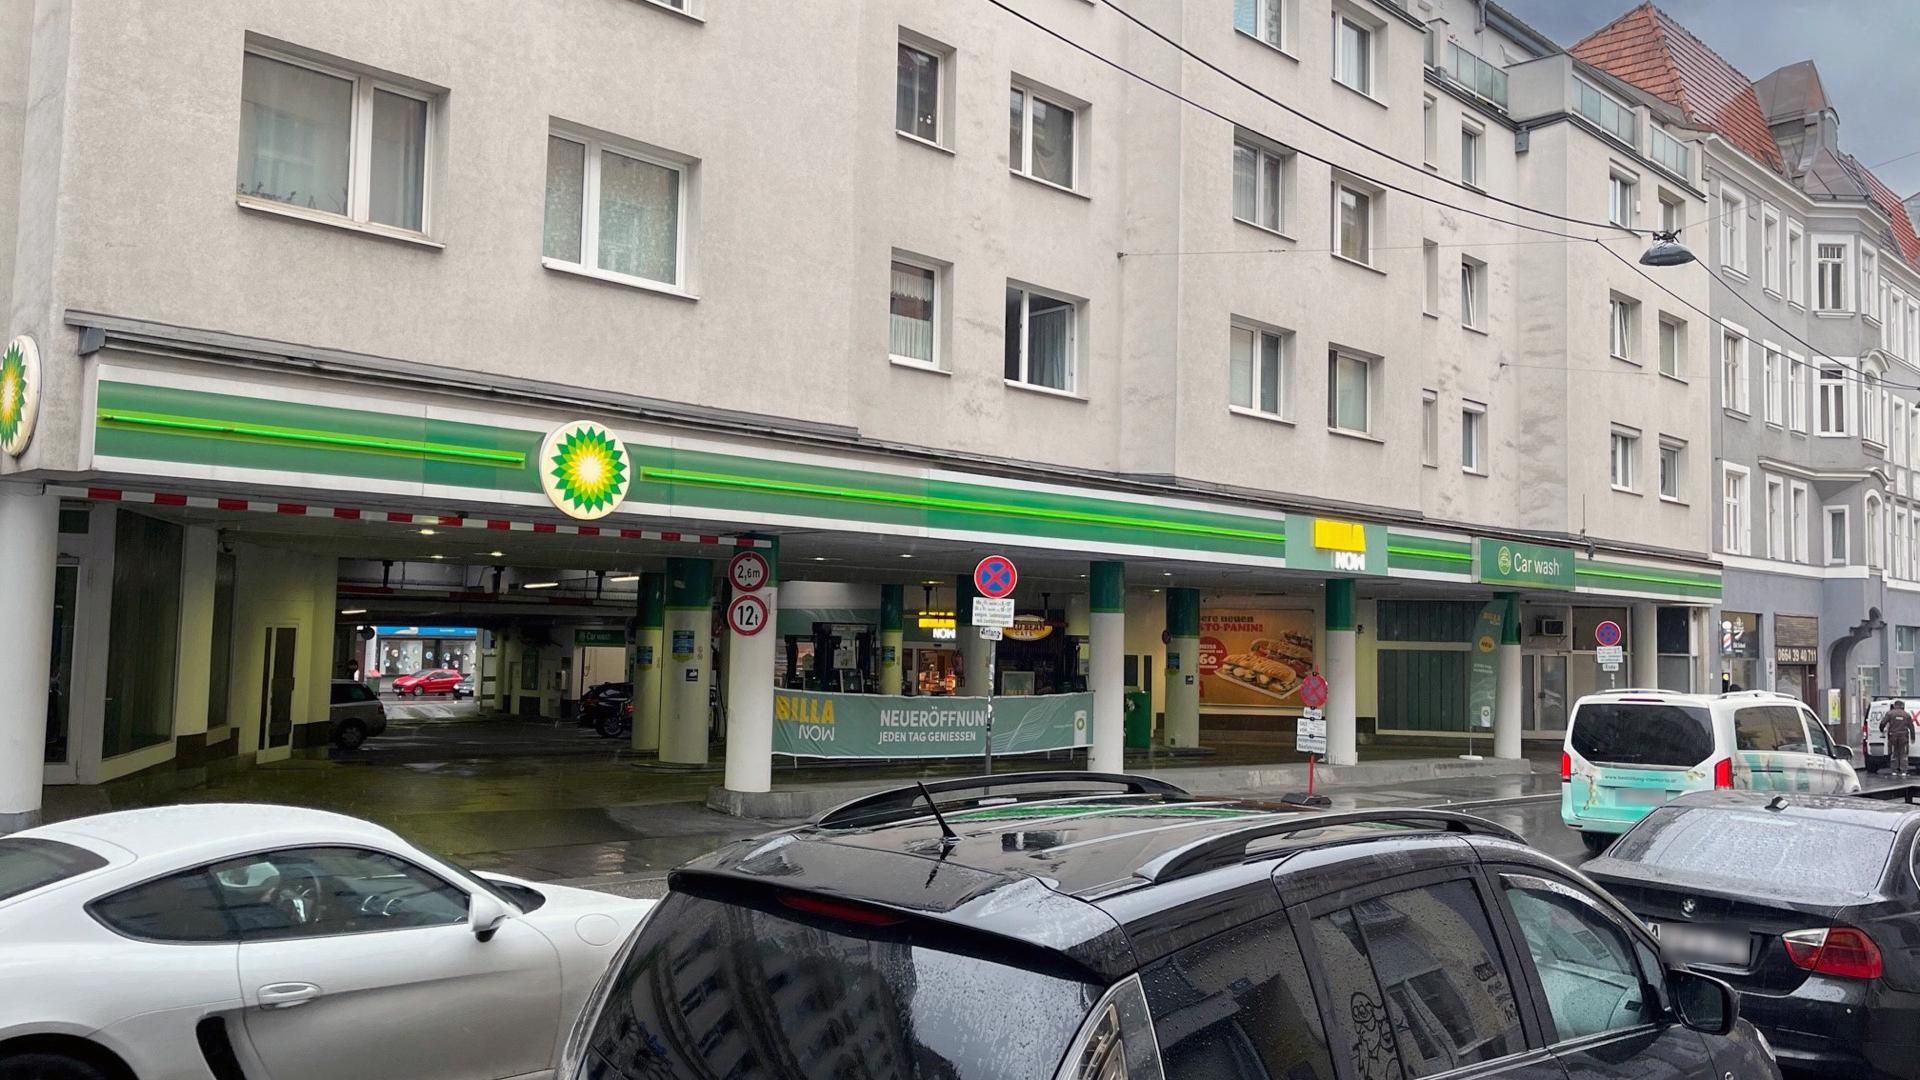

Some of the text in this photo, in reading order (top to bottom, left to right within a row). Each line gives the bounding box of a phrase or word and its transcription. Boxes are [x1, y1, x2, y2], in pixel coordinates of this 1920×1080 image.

[1514, 552, 1560, 577] Car wash
[737, 565, 760, 581] 2,6m
[737, 605, 759, 626] 12t
[1220, 615, 1254, 623] neuen
[1792, 648, 1799, 661] 39
[775, 696, 835, 724] BILLA
[799, 725, 835, 741] NOW
[878, 731, 976, 744] JEDEN TAG GENIESSEN
